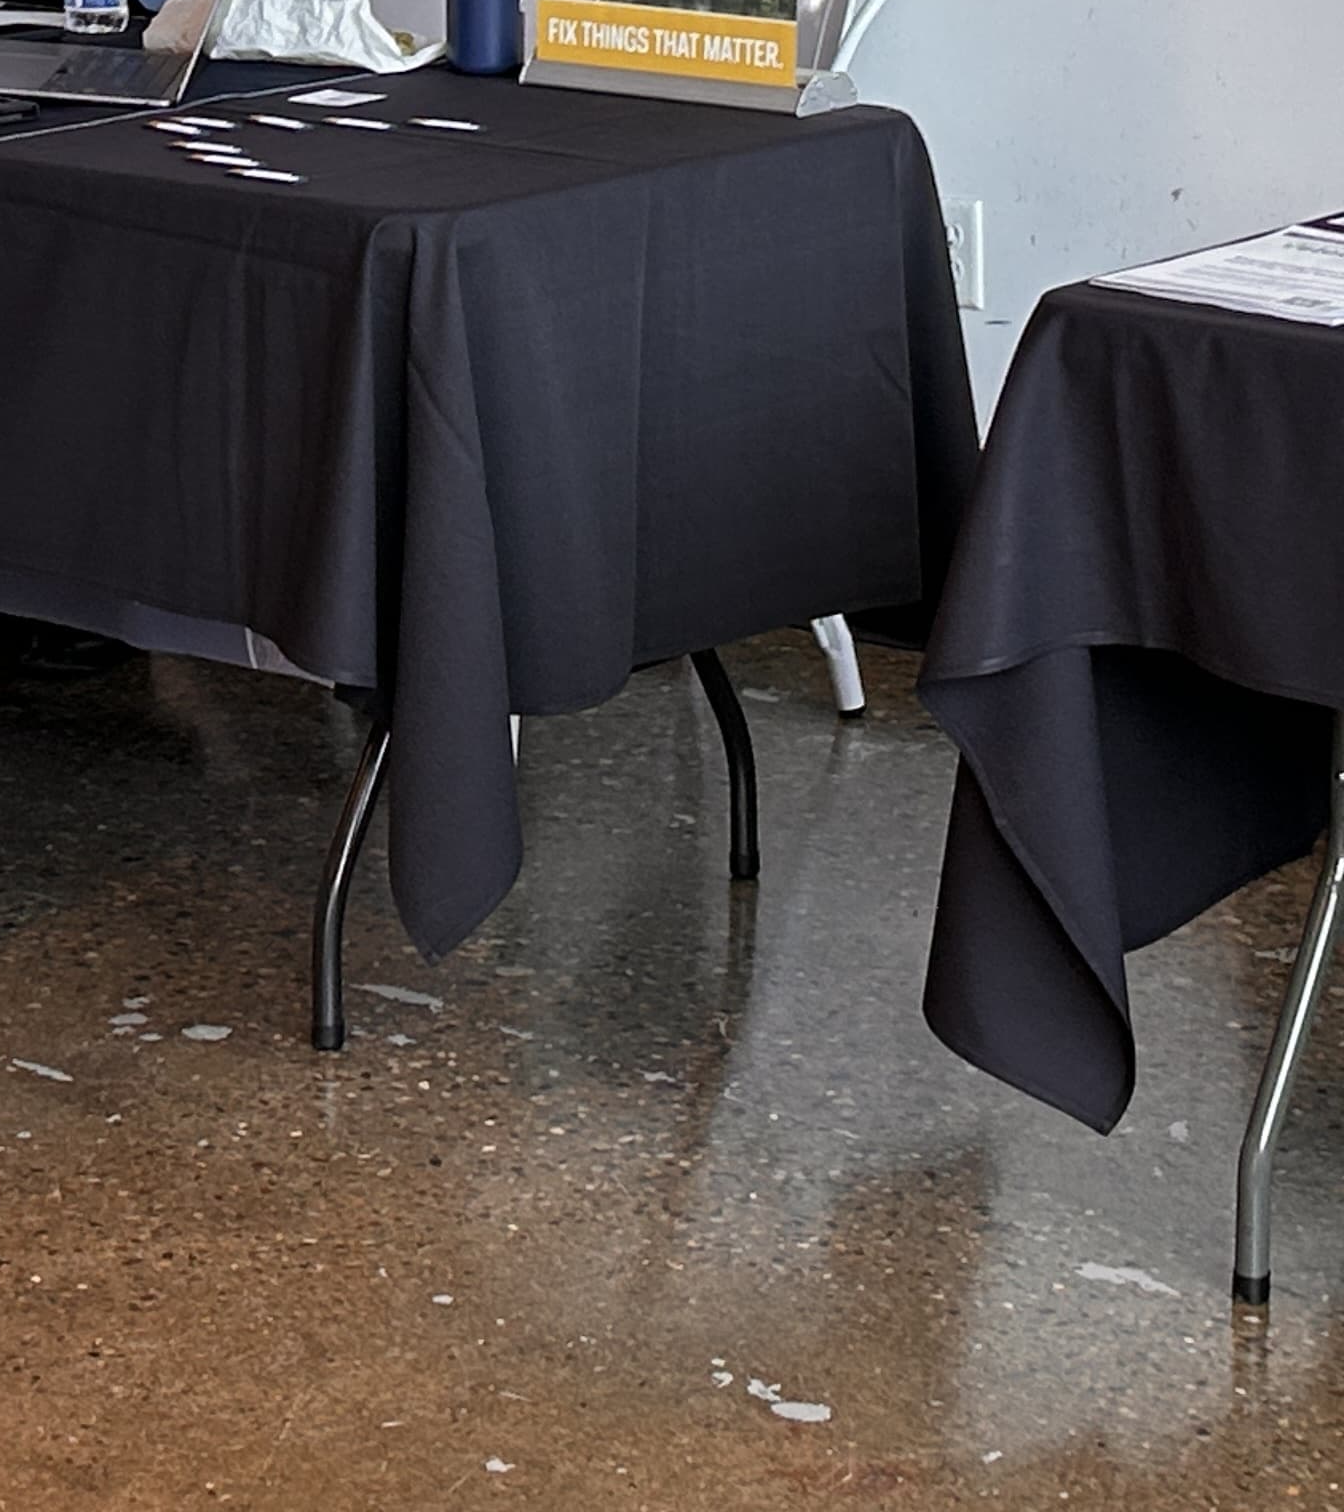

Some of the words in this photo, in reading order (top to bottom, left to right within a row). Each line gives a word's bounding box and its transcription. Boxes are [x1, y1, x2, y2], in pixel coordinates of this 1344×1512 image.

[548, 17, 578, 46] FIX
[580, 20, 649, 54] THINGS
[653, 28, 701, 59] THAT
[703, 34, 784, 69] MATTER.
